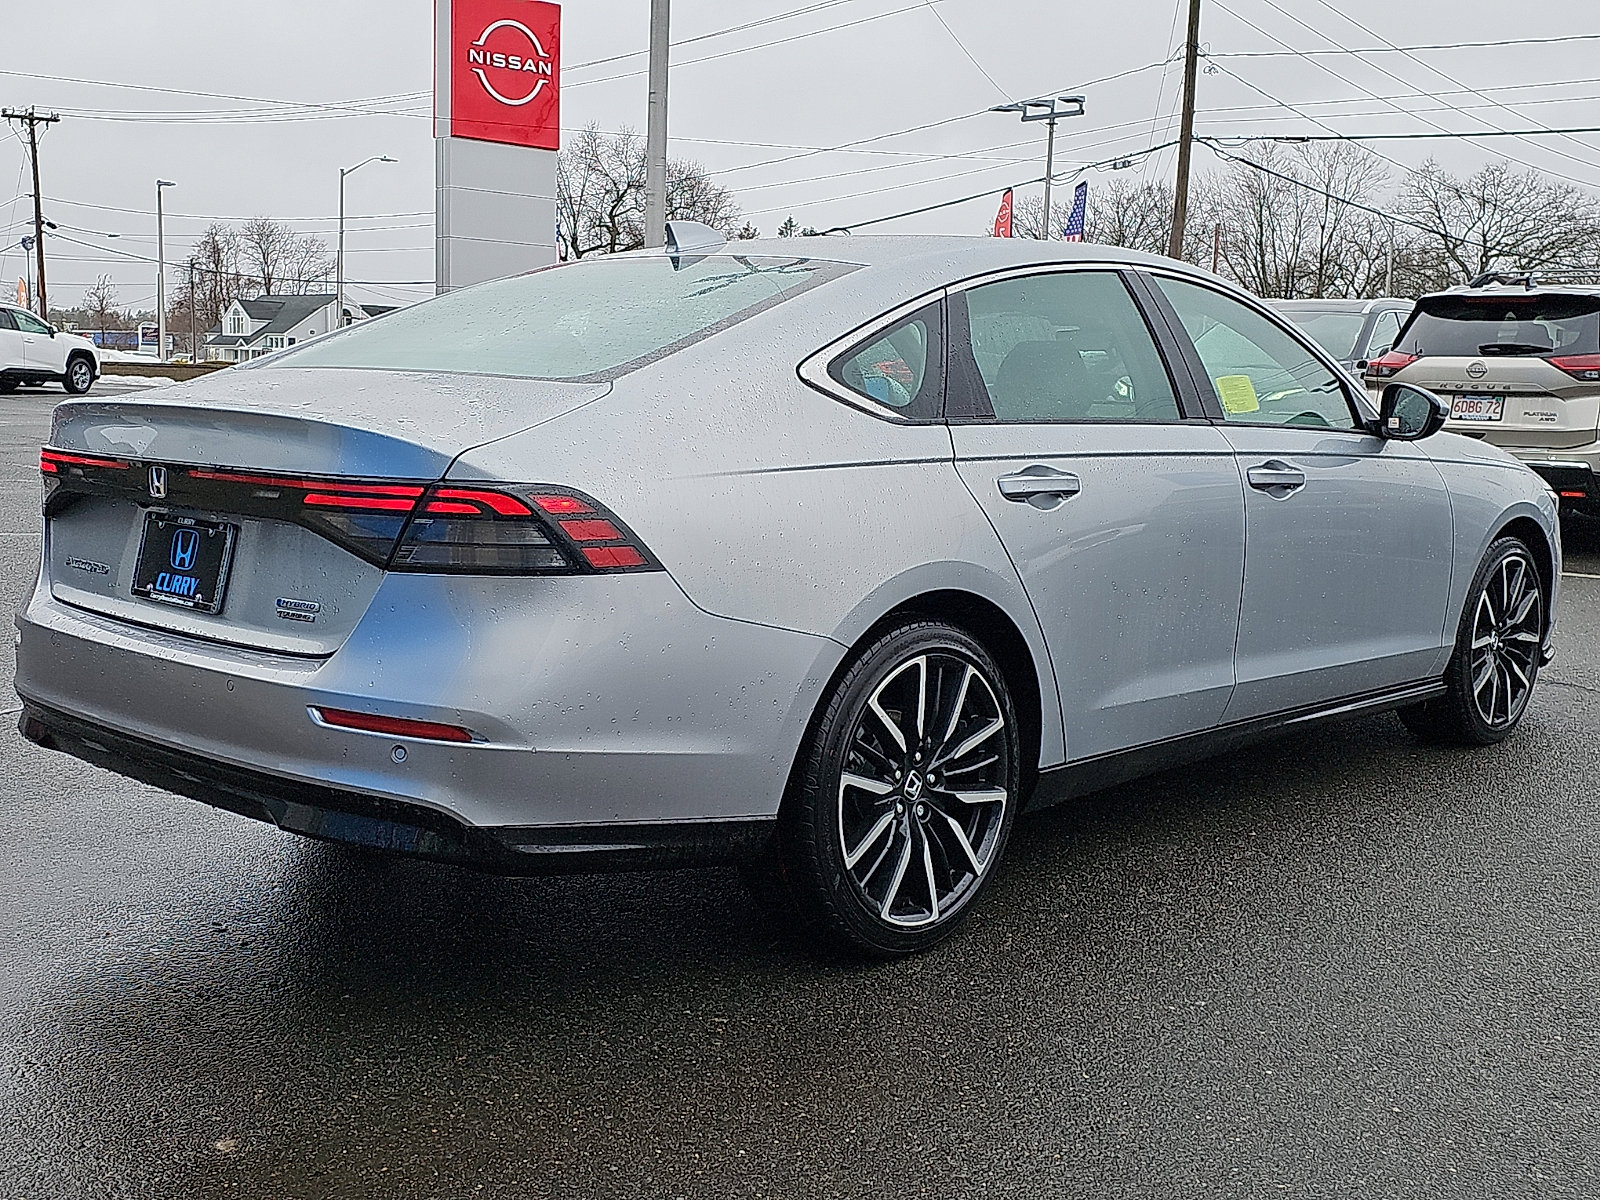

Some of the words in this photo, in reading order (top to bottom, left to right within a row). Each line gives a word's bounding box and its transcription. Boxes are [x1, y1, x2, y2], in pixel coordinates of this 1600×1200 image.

[469, 48, 552, 76] NISSAN
[1453, 400, 1483, 414] 6DBG
[1485, 400, 1501, 415] 72
[155, 572, 200, 597] CURRY
[281, 599, 316, 610] HYBRID
